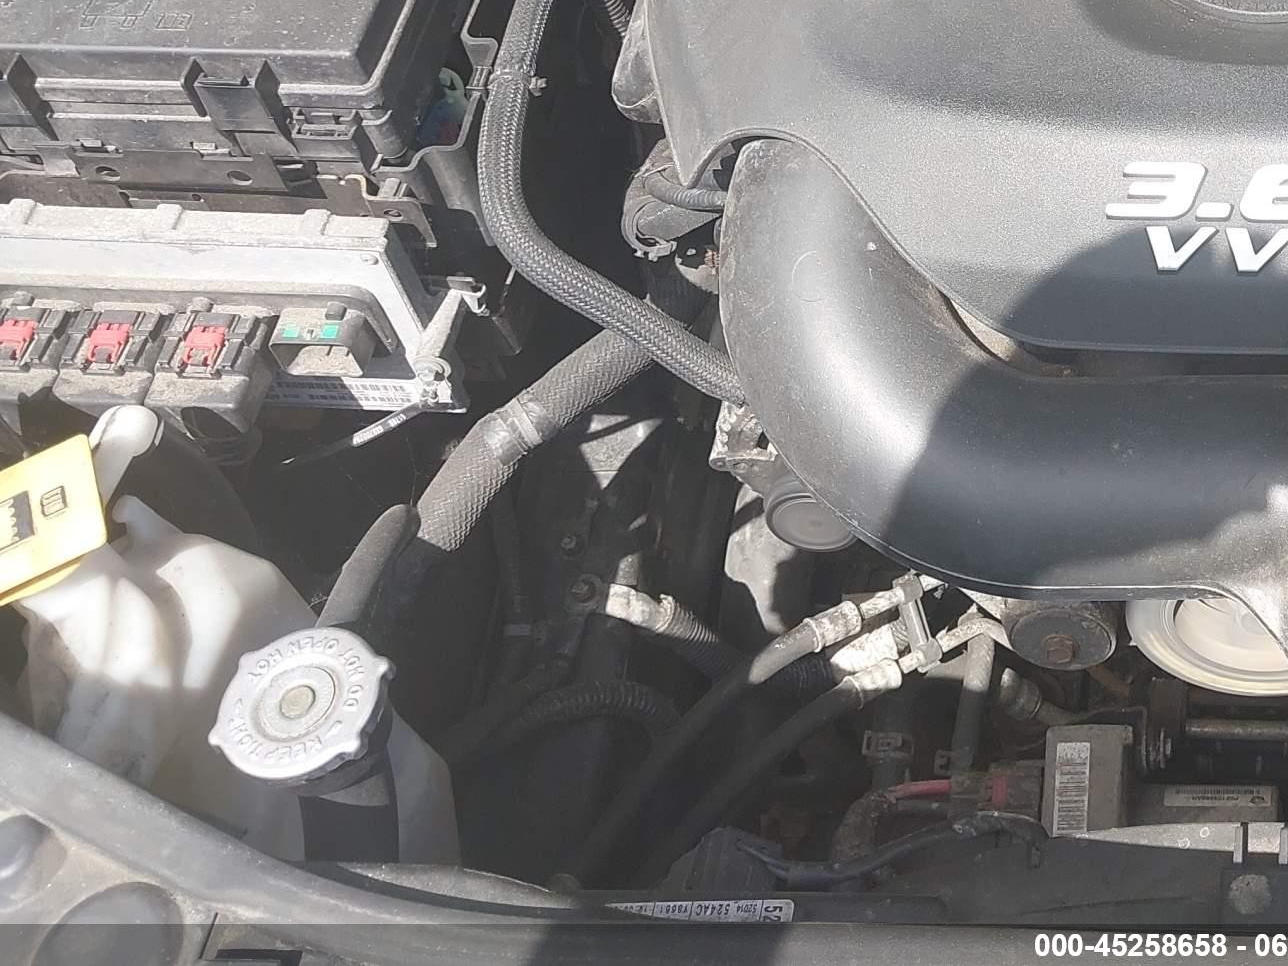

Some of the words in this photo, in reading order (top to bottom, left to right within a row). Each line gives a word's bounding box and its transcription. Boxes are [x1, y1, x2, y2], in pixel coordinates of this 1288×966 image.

[286, 636, 340, 657] OPEN
[248, 649, 283, 680] HOT
[338, 648, 366, 679] NOT
[343, 684, 365, 710] DO
[263, 735, 323, 763] KEEP
[695, 903, 730, 917] 524AC
